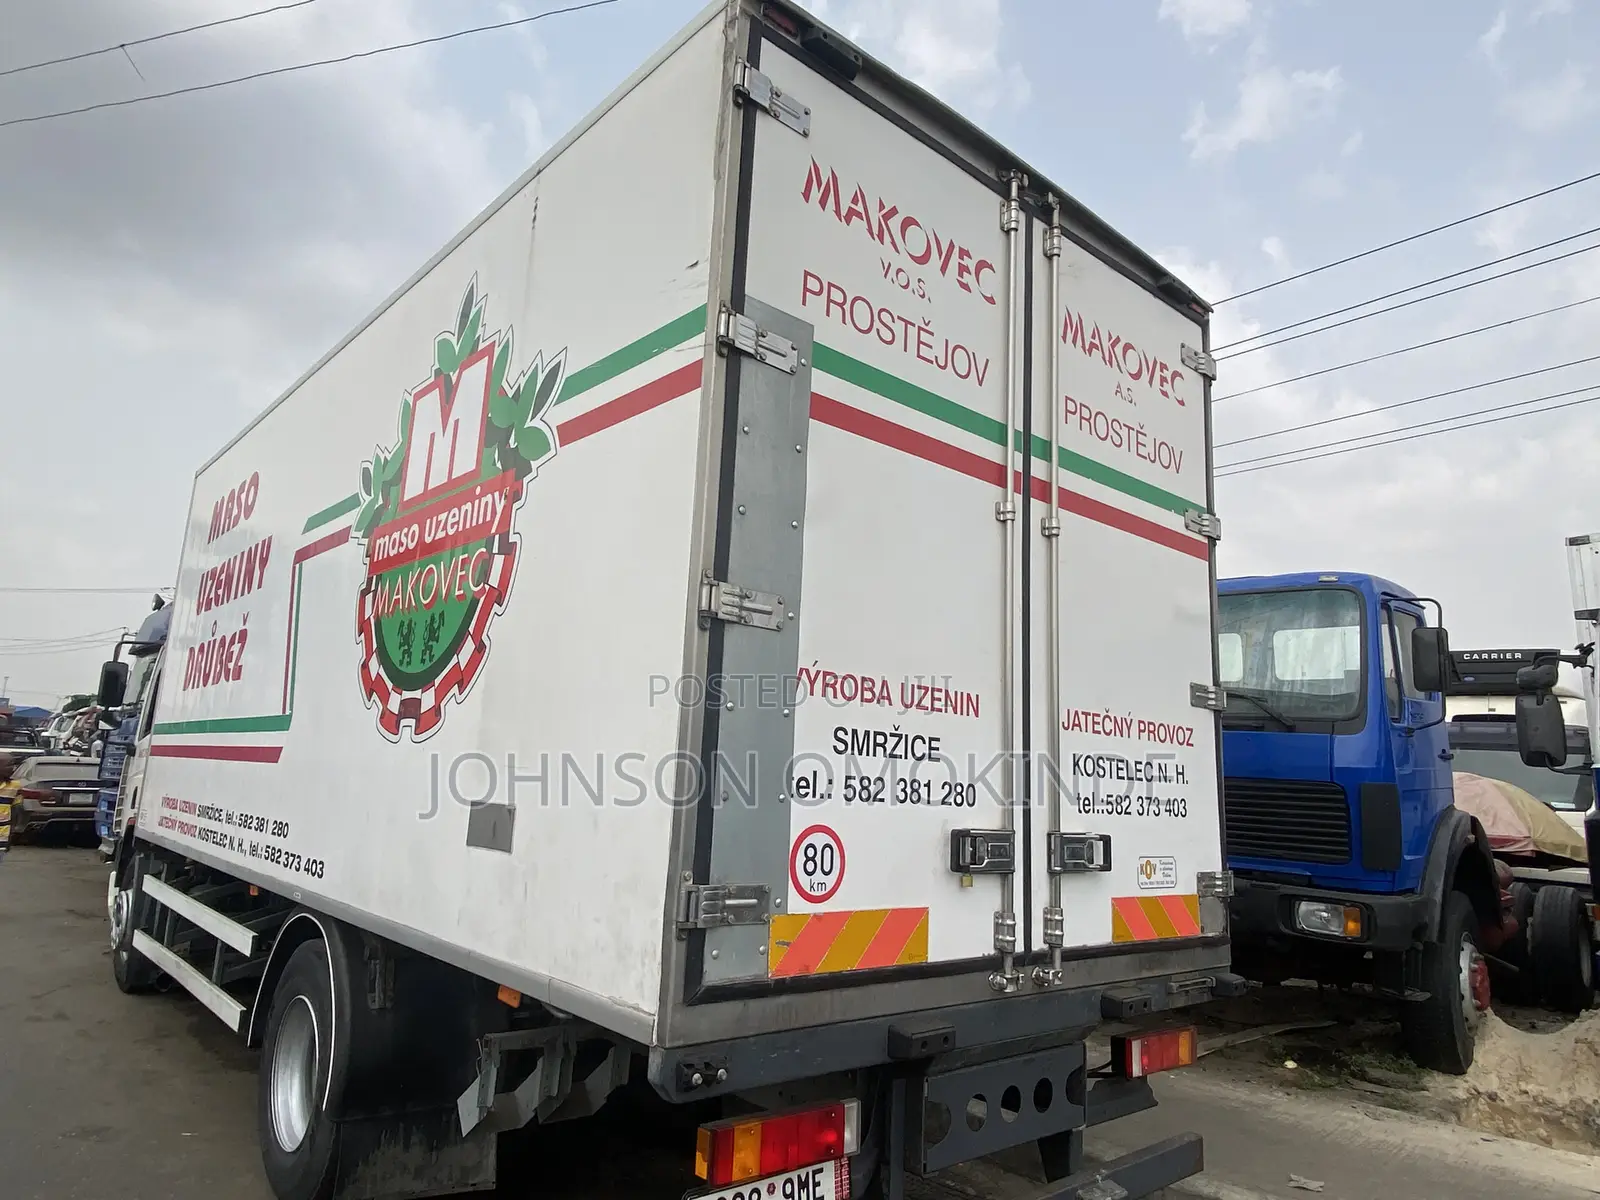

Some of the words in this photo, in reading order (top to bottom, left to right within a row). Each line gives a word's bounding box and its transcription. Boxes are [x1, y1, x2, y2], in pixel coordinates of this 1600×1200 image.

[800, 154, 997, 305] MAKOVEC
[879, 257, 932, 303] V.O.S.
[801, 270, 990, 387] PROSTĚJOV
[1061, 305, 1186, 407] MAKOVEC
[1114, 381, 1137, 407] A.S.
[404, 355, 490, 501] M
[1064, 395, 1184, 474] PROSTĚJOV
[207, 471, 260, 544] MASO
[373, 523, 419, 562] maso
[424, 486, 509, 544] uzeniny
[196, 535, 273, 616] UZENINY
[373, 547, 488, 617] MAKOVEC
[182, 612, 250, 691] DRŮBEŽ
[1463, 652, 1522, 660] CARRIER
[900, 682, 980, 718] UZENIN
[833, 724, 941, 763] SMRŽICE
[1062, 708, 1133, 739] JATEČNÝ
[1138, 719, 1194, 747] PROVOZ
[843, 775, 886, 803] 582
[895, 778, 932, 805] 381
[940, 781, 977, 807] 280
[1072, 753, 1154, 783] KOSTELEC
[179, 800, 198, 816] UZENIN
[254, 816, 269, 834] 381
[271, 820, 289, 839] 280
[1136, 796, 1161, 817] 373
[1165, 798, 1187, 818] 403
[177, 820, 198, 838] PROVOZ
[197, 826, 228, 849] KOSTELEC
[282, 851, 301, 872] 373
[304, 857, 325, 879] 403
[802, 842, 835, 877] 80
[808, 879, 828, 893] km
